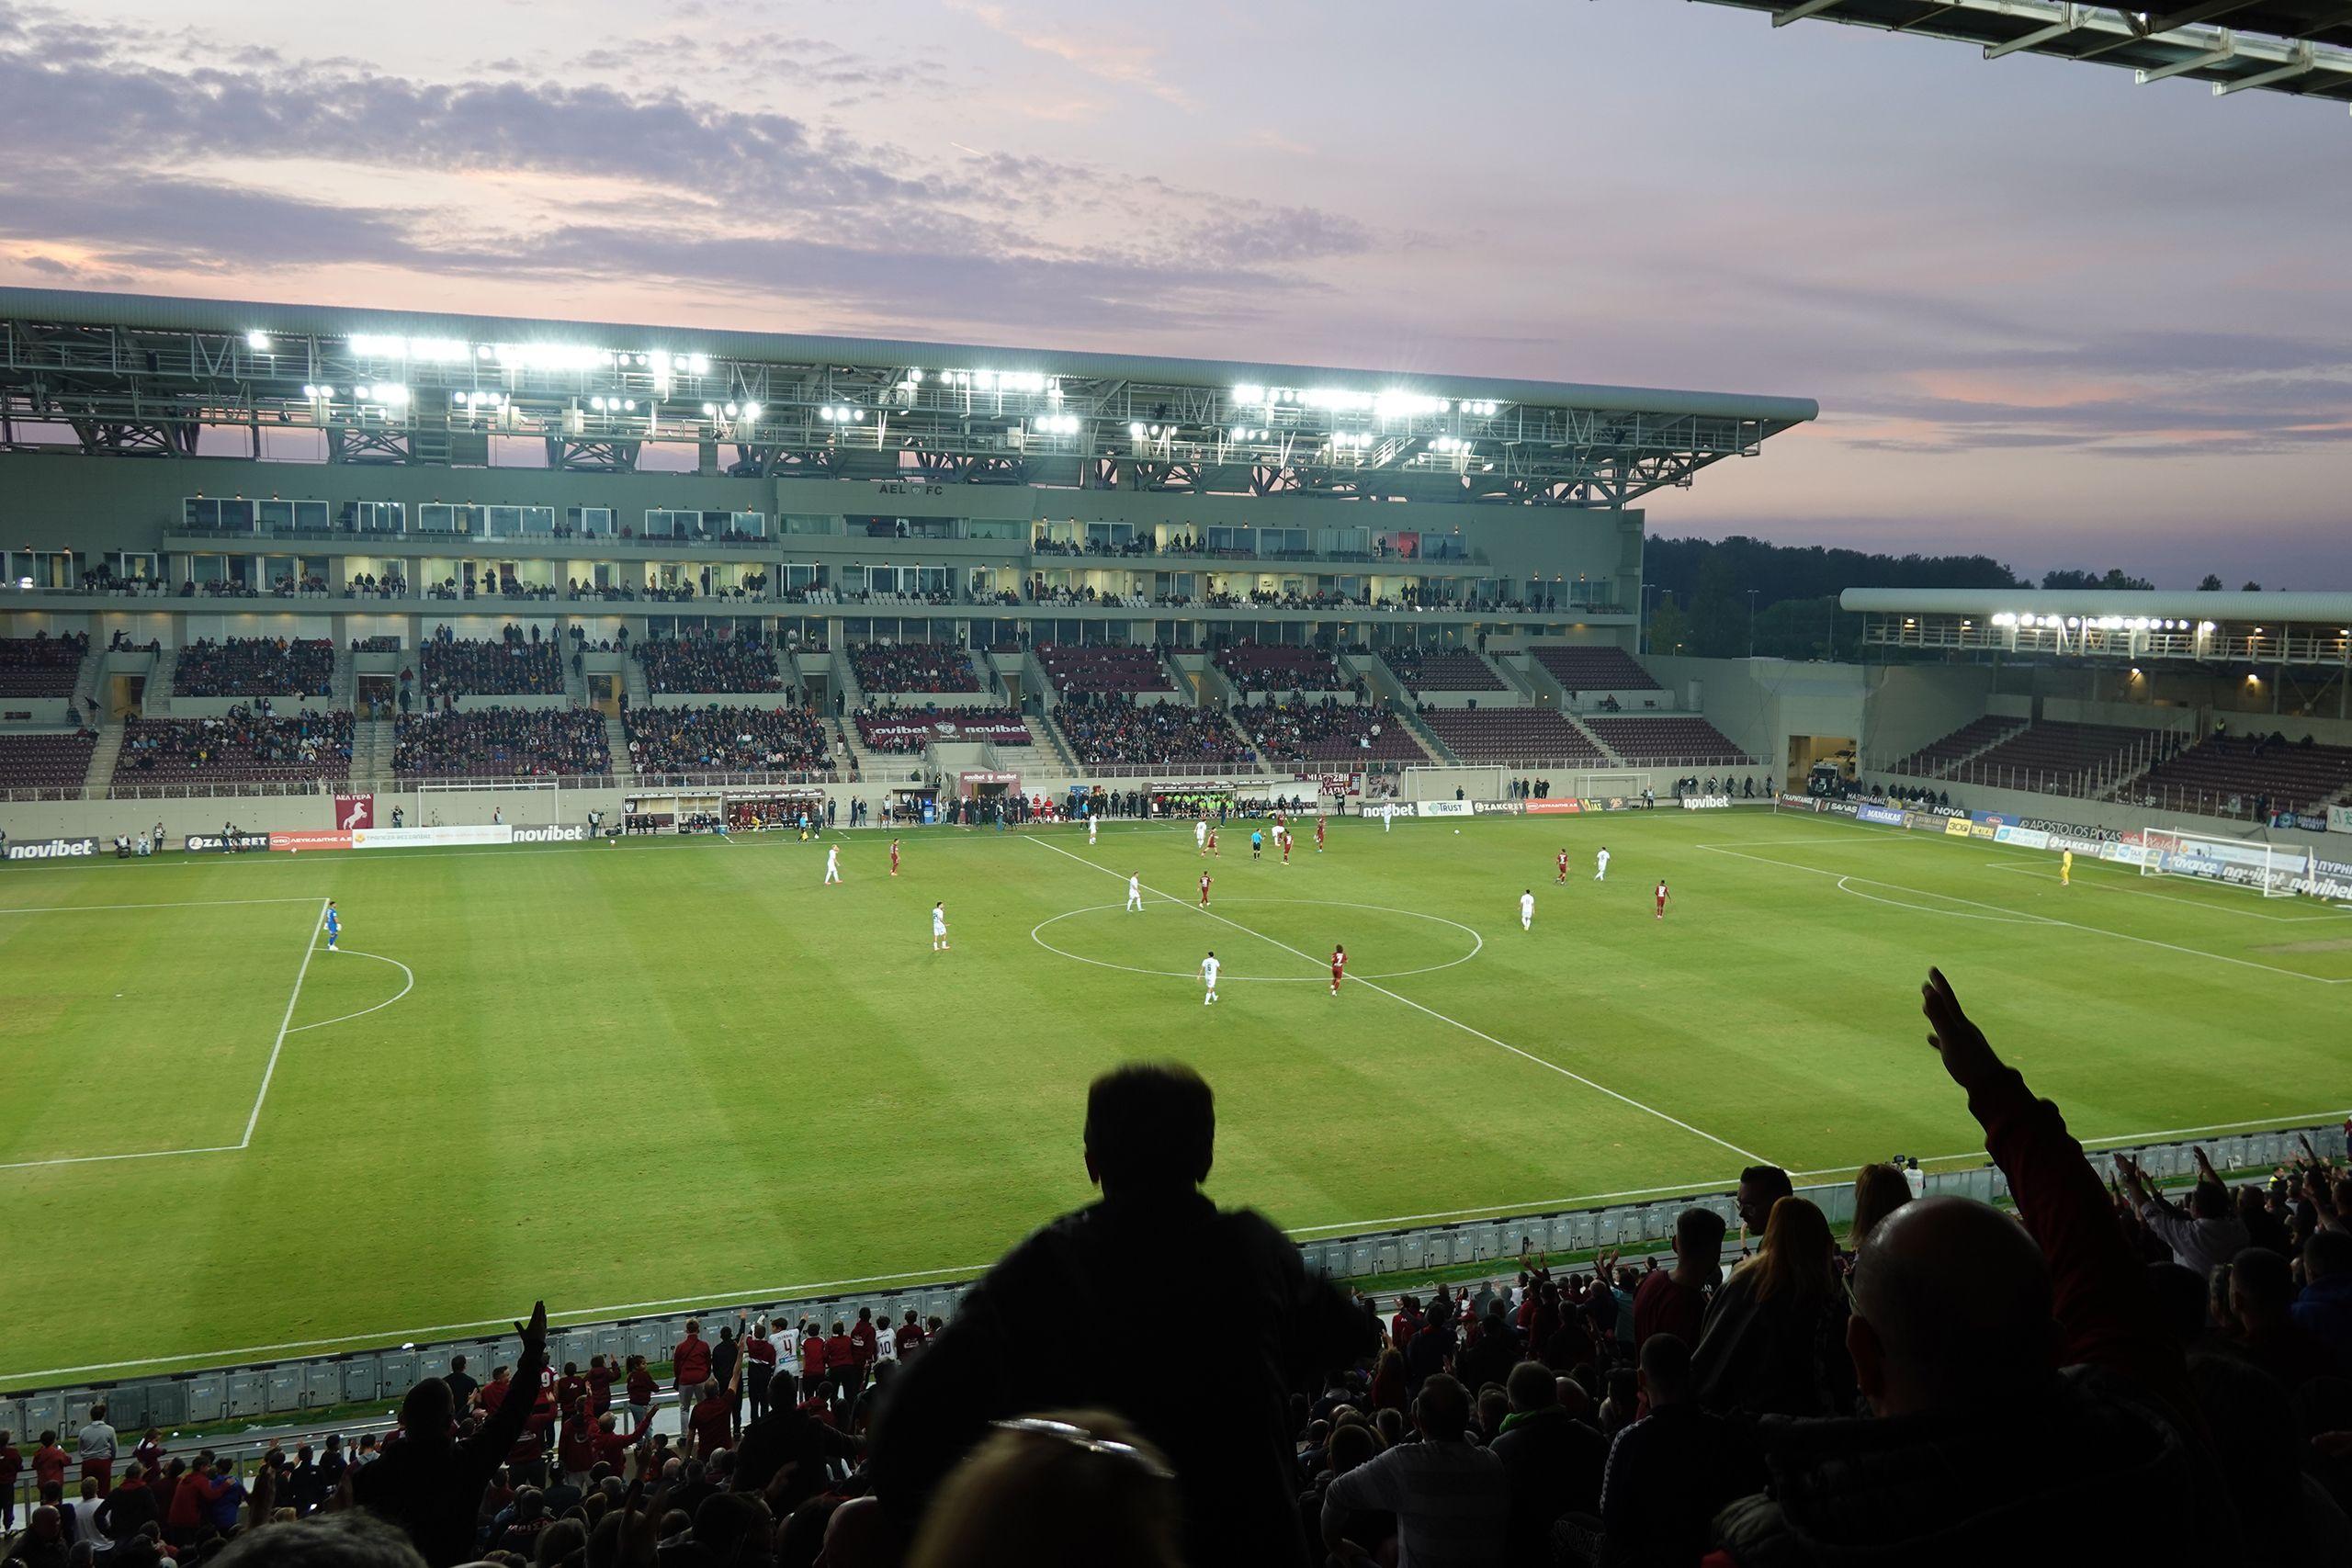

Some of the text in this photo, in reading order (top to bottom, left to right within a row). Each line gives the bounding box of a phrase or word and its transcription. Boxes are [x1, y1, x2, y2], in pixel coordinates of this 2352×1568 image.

[879, 484, 943, 495] AEL FC
[965, 724, 1028, 733] novibet
[1683, 795, 1729, 809] novibet
[1363, 803, 1415, 818] nobet
[1933, 806, 1965, 818] NOVA
[514, 826, 583, 841] novibet
[2030, 820, 2089, 839] APOSTOLOS
[9, 839, 92, 859] novibet
[203, 837, 266, 848] ZARET
[2058, 839, 2102, 853] ZAKCRET
[783, 1339, 792, 1354] 4
[879, 1340, 891, 1356] 10
